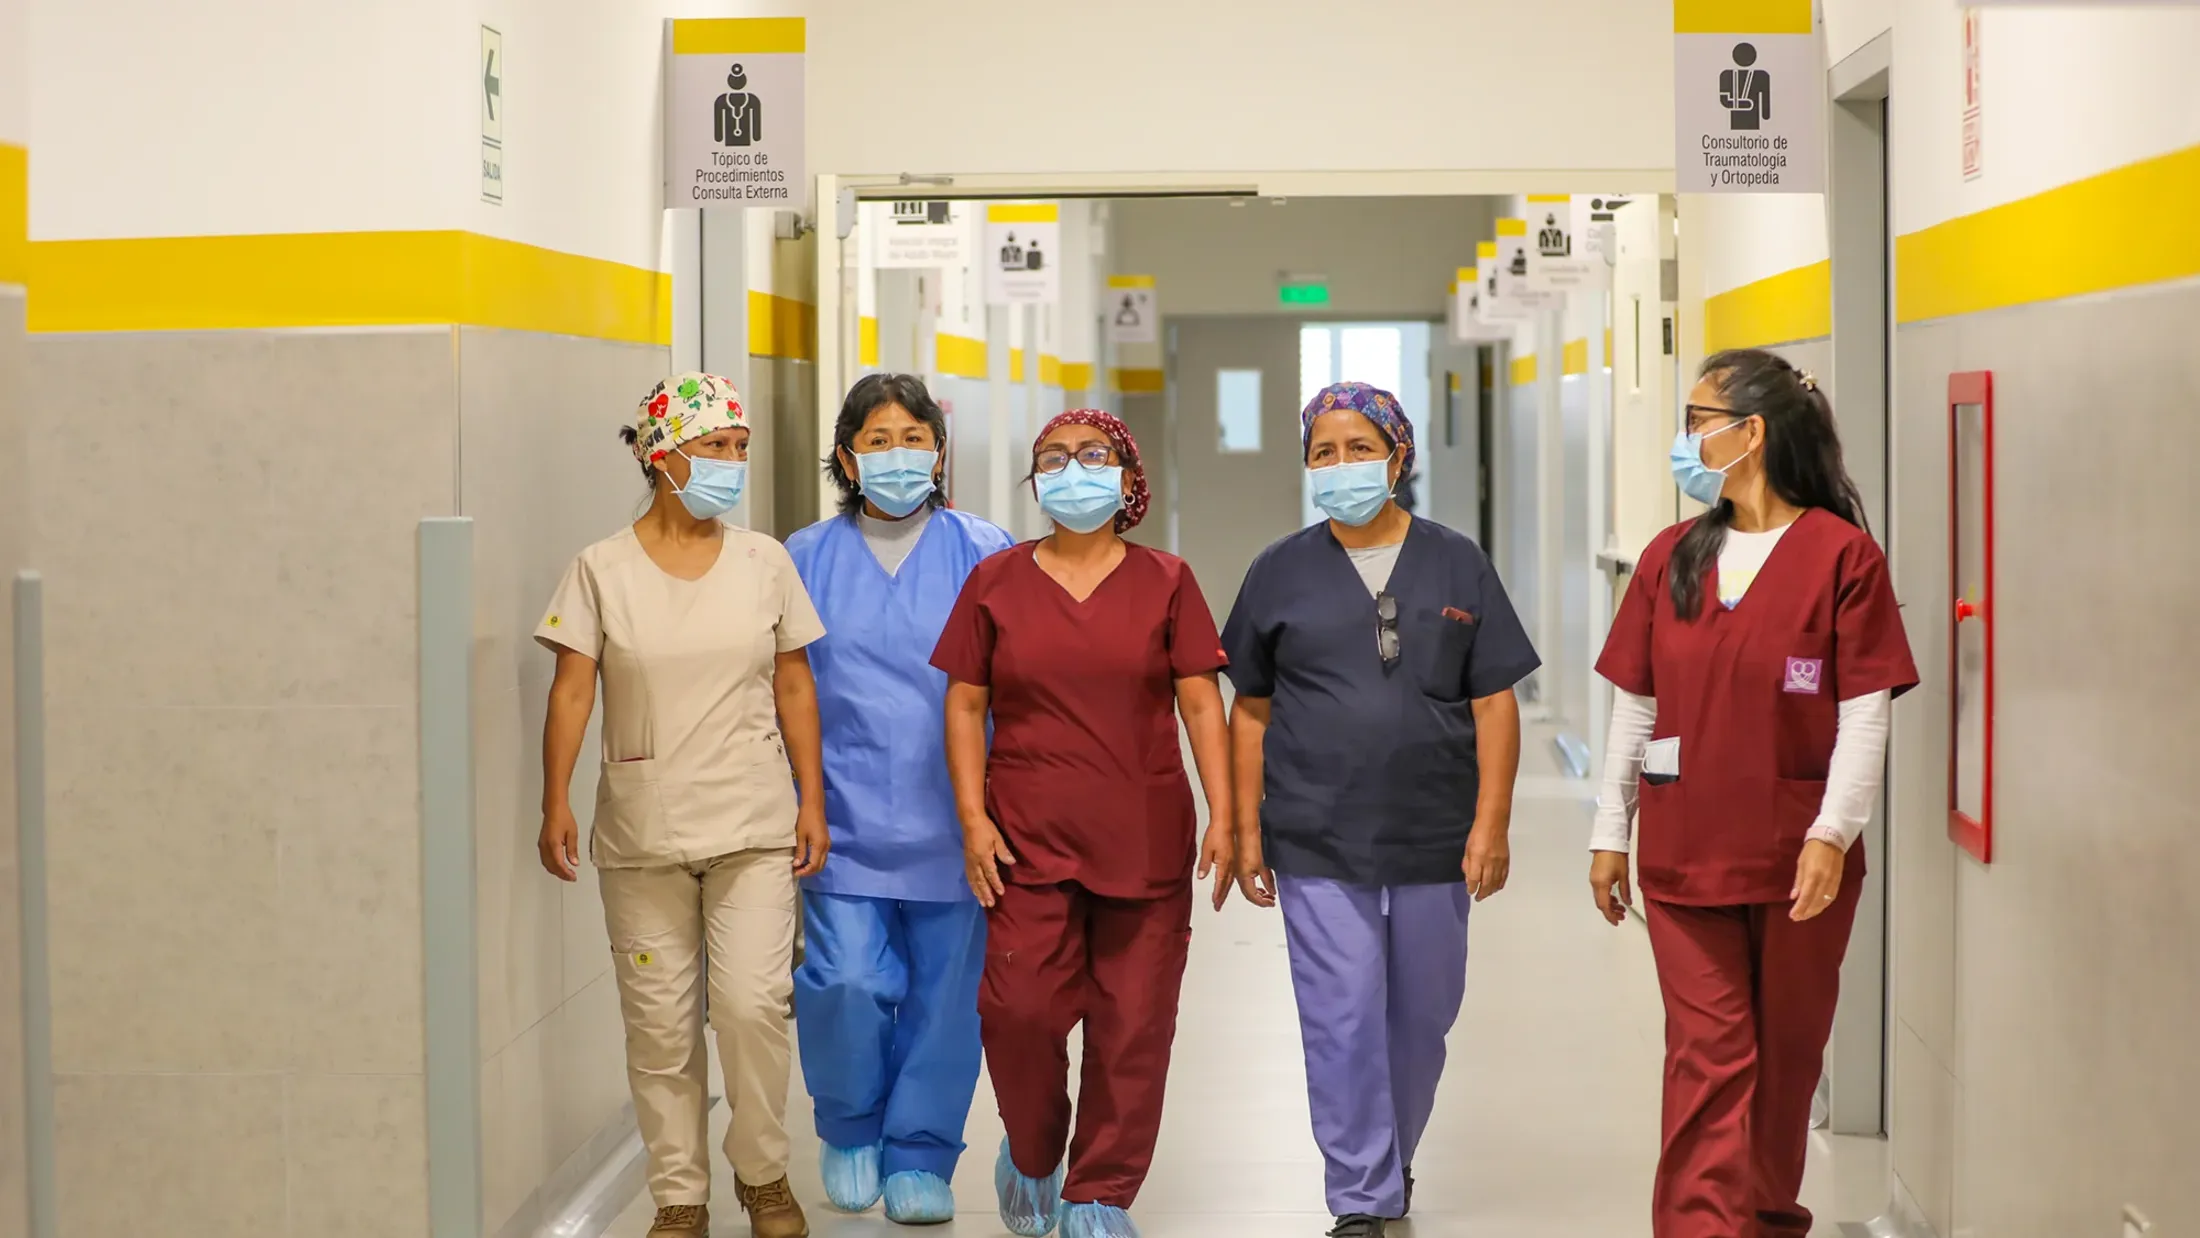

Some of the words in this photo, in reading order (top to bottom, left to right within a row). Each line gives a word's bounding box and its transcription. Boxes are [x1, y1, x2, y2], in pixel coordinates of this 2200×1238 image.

[1702, 134, 1770, 150] Consultorio
[1773, 135, 1788, 150] de
[711, 152, 751, 168] Tópico
[754, 152, 768, 165] de
[1703, 152, 1787, 170] Traumatología
[483, 159, 501, 181] SALIDA
[696, 168, 785, 183] Procedimientos
[1710, 172, 1718, 187] y
[1721, 169, 1780, 187] Ortopedia
[692, 185, 742, 200] Consulta
[746, 185, 788, 199] Externa
